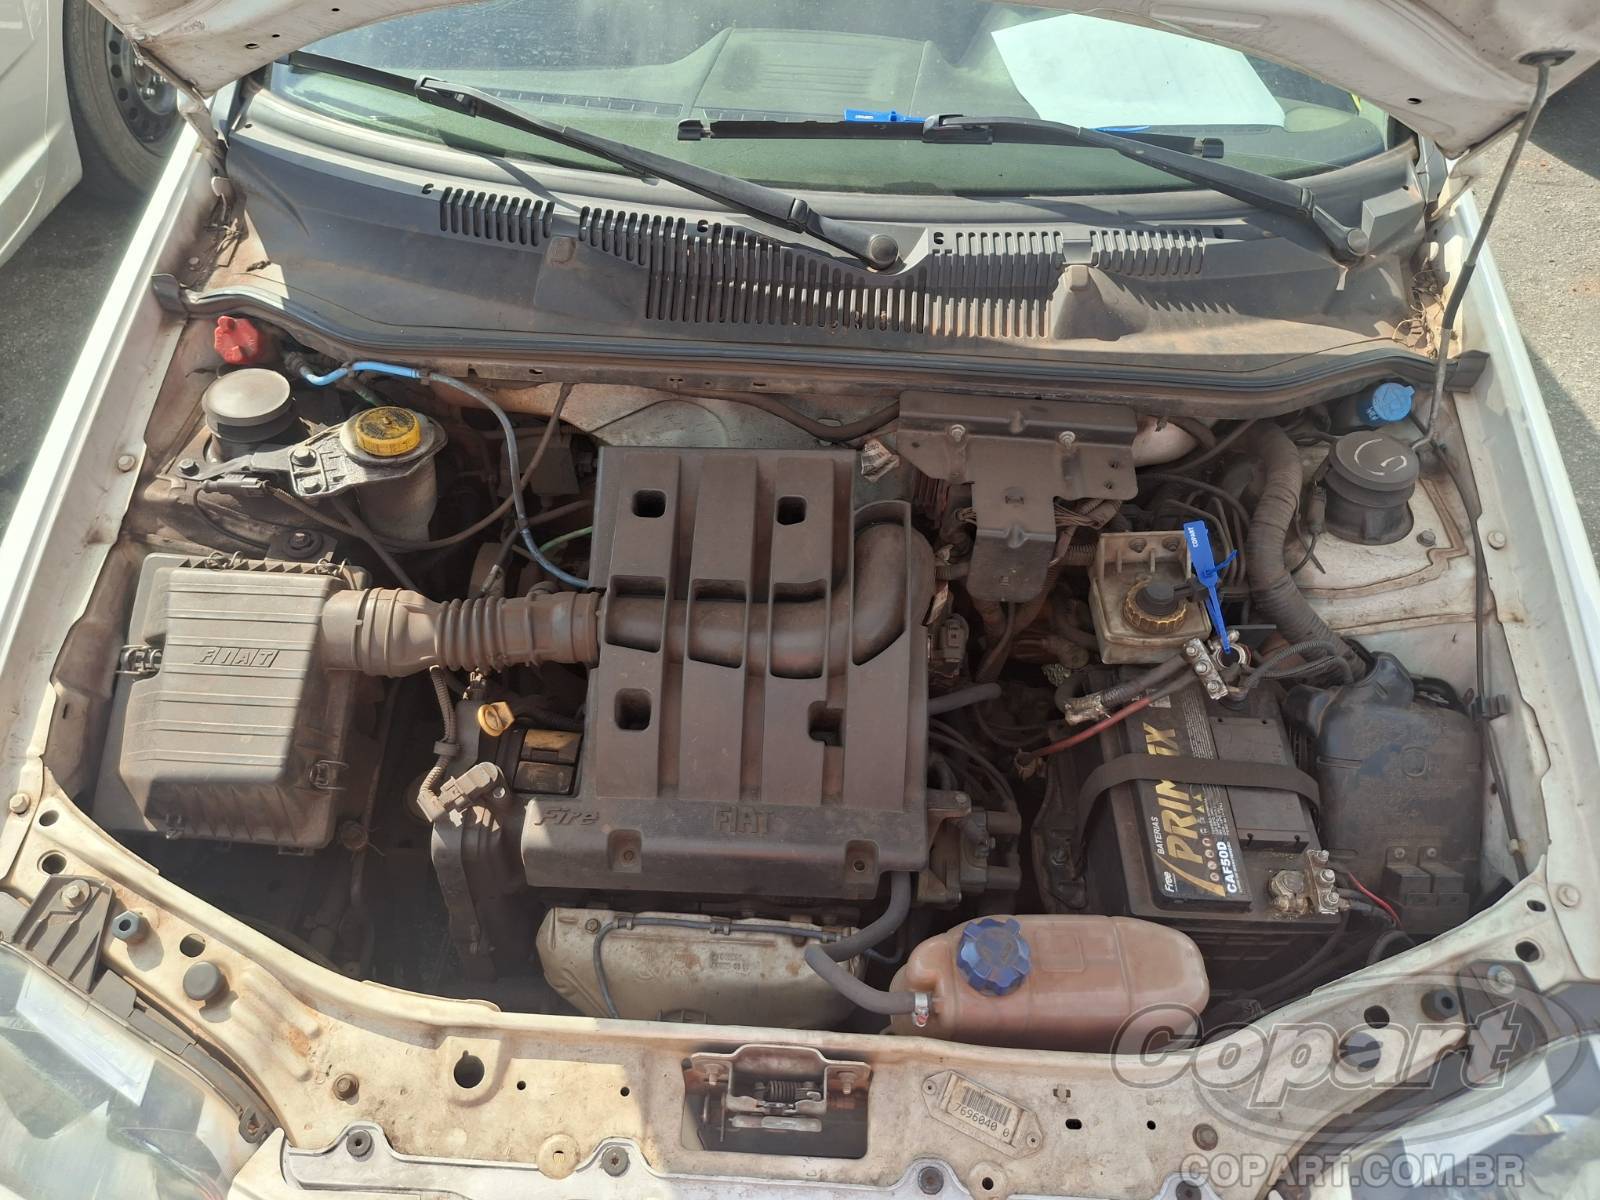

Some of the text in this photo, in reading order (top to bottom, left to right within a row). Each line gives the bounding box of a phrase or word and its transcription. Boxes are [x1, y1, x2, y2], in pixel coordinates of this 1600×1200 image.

[1187, 527, 1199, 548] COPART
[199, 648, 274, 666] FIAT
[534, 808, 600, 826] Fire
[713, 806, 775, 834] FIAT
[1150, 816, 1165, 855] BATERIAS
[1215, 841, 1238, 893] CAF50D
[1163, 871, 1175, 893] Free
[953, 1102, 998, 1132] 7696040
